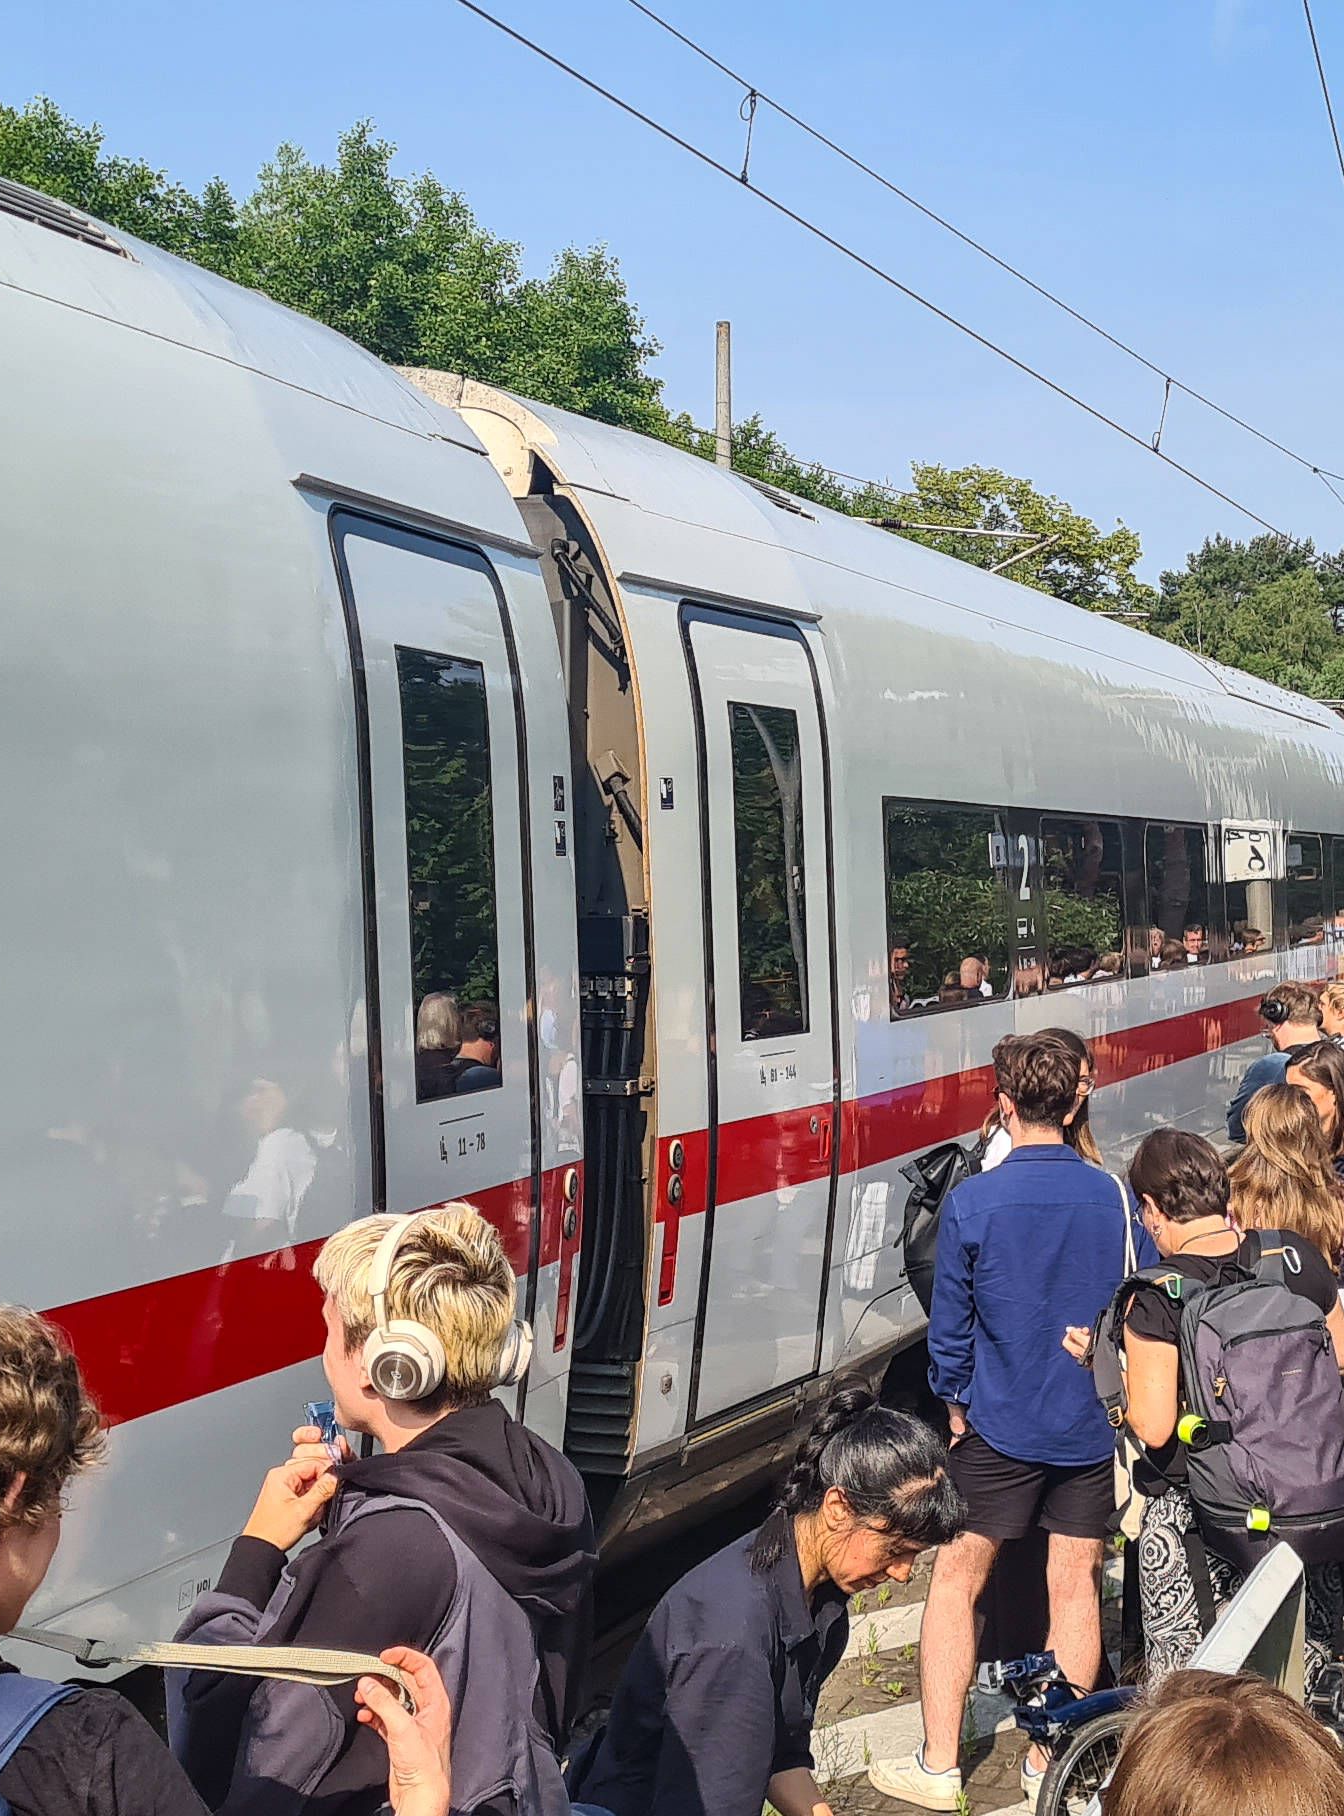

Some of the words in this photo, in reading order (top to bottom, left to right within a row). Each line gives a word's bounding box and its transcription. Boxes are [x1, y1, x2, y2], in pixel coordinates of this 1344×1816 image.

[1017, 833, 1031, 900] 2
[458, 1137, 467, 1157] 11
[475, 1131, 486, 1153] 78
